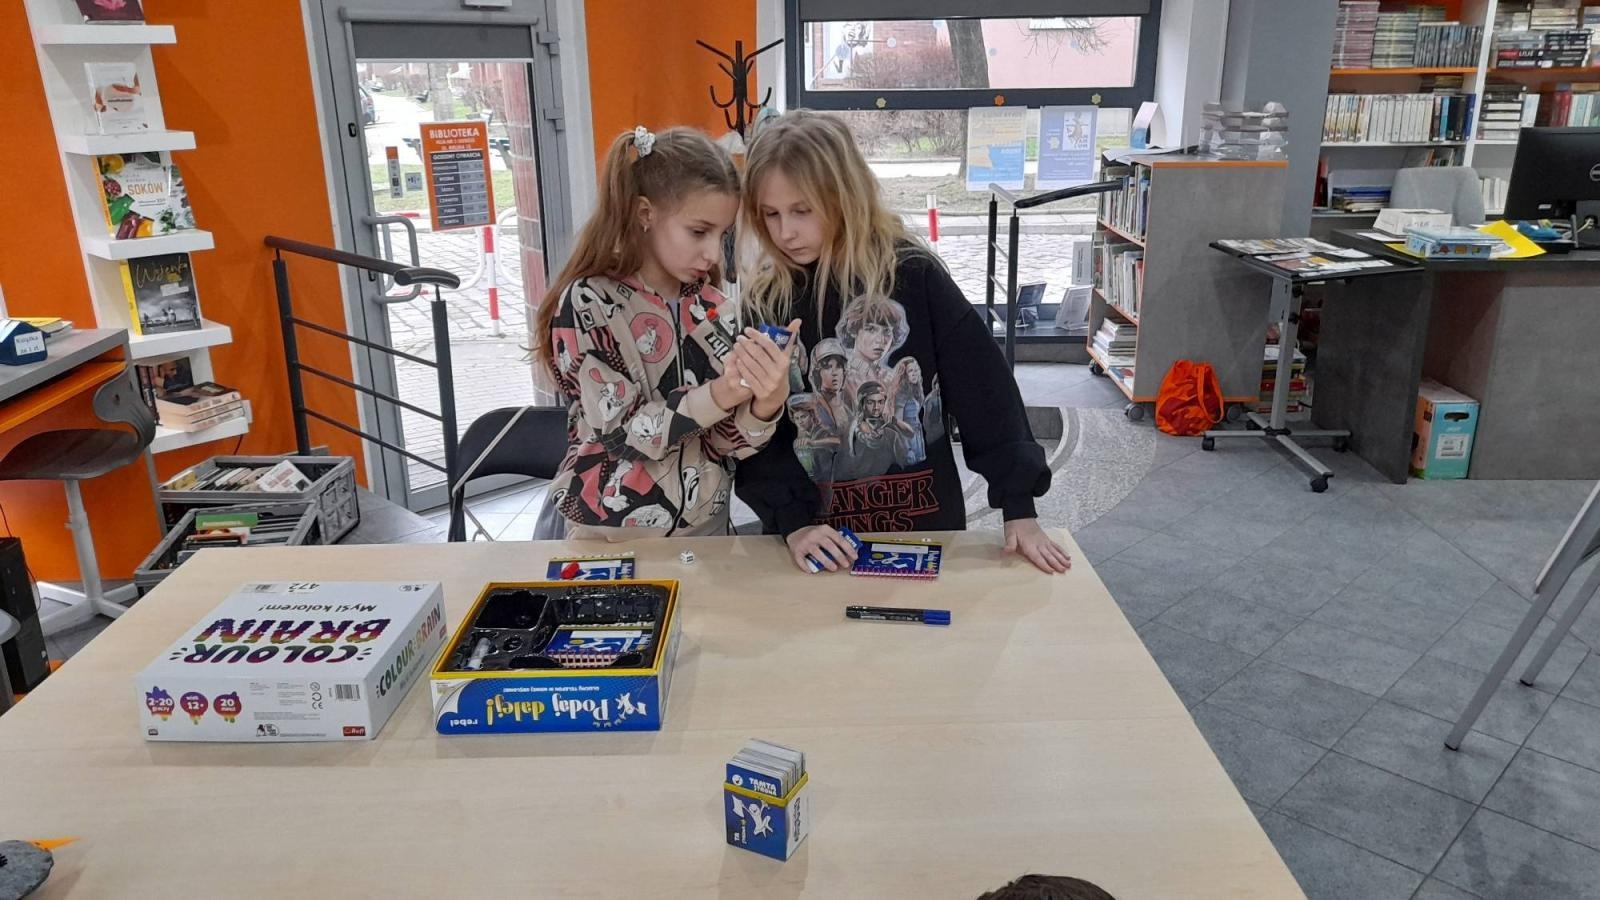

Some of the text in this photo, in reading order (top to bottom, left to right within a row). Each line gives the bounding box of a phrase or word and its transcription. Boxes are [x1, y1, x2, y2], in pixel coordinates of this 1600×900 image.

[429, 128, 480, 139] BIBLIOTEKA
[827, 475, 939, 513] ANGER
[258, 604, 333, 613] kolorem!
[193, 618, 391, 644] BRAIN
[184, 644, 359, 664] COLOUR
[379, 603, 441, 696] COLOUR BRAIN
[148, 697, 173, 706] 2-20
[220, 698, 235, 707] 20
[486, 692, 610, 726] Podaj dalej!
[450, 719, 479, 727] rebel
